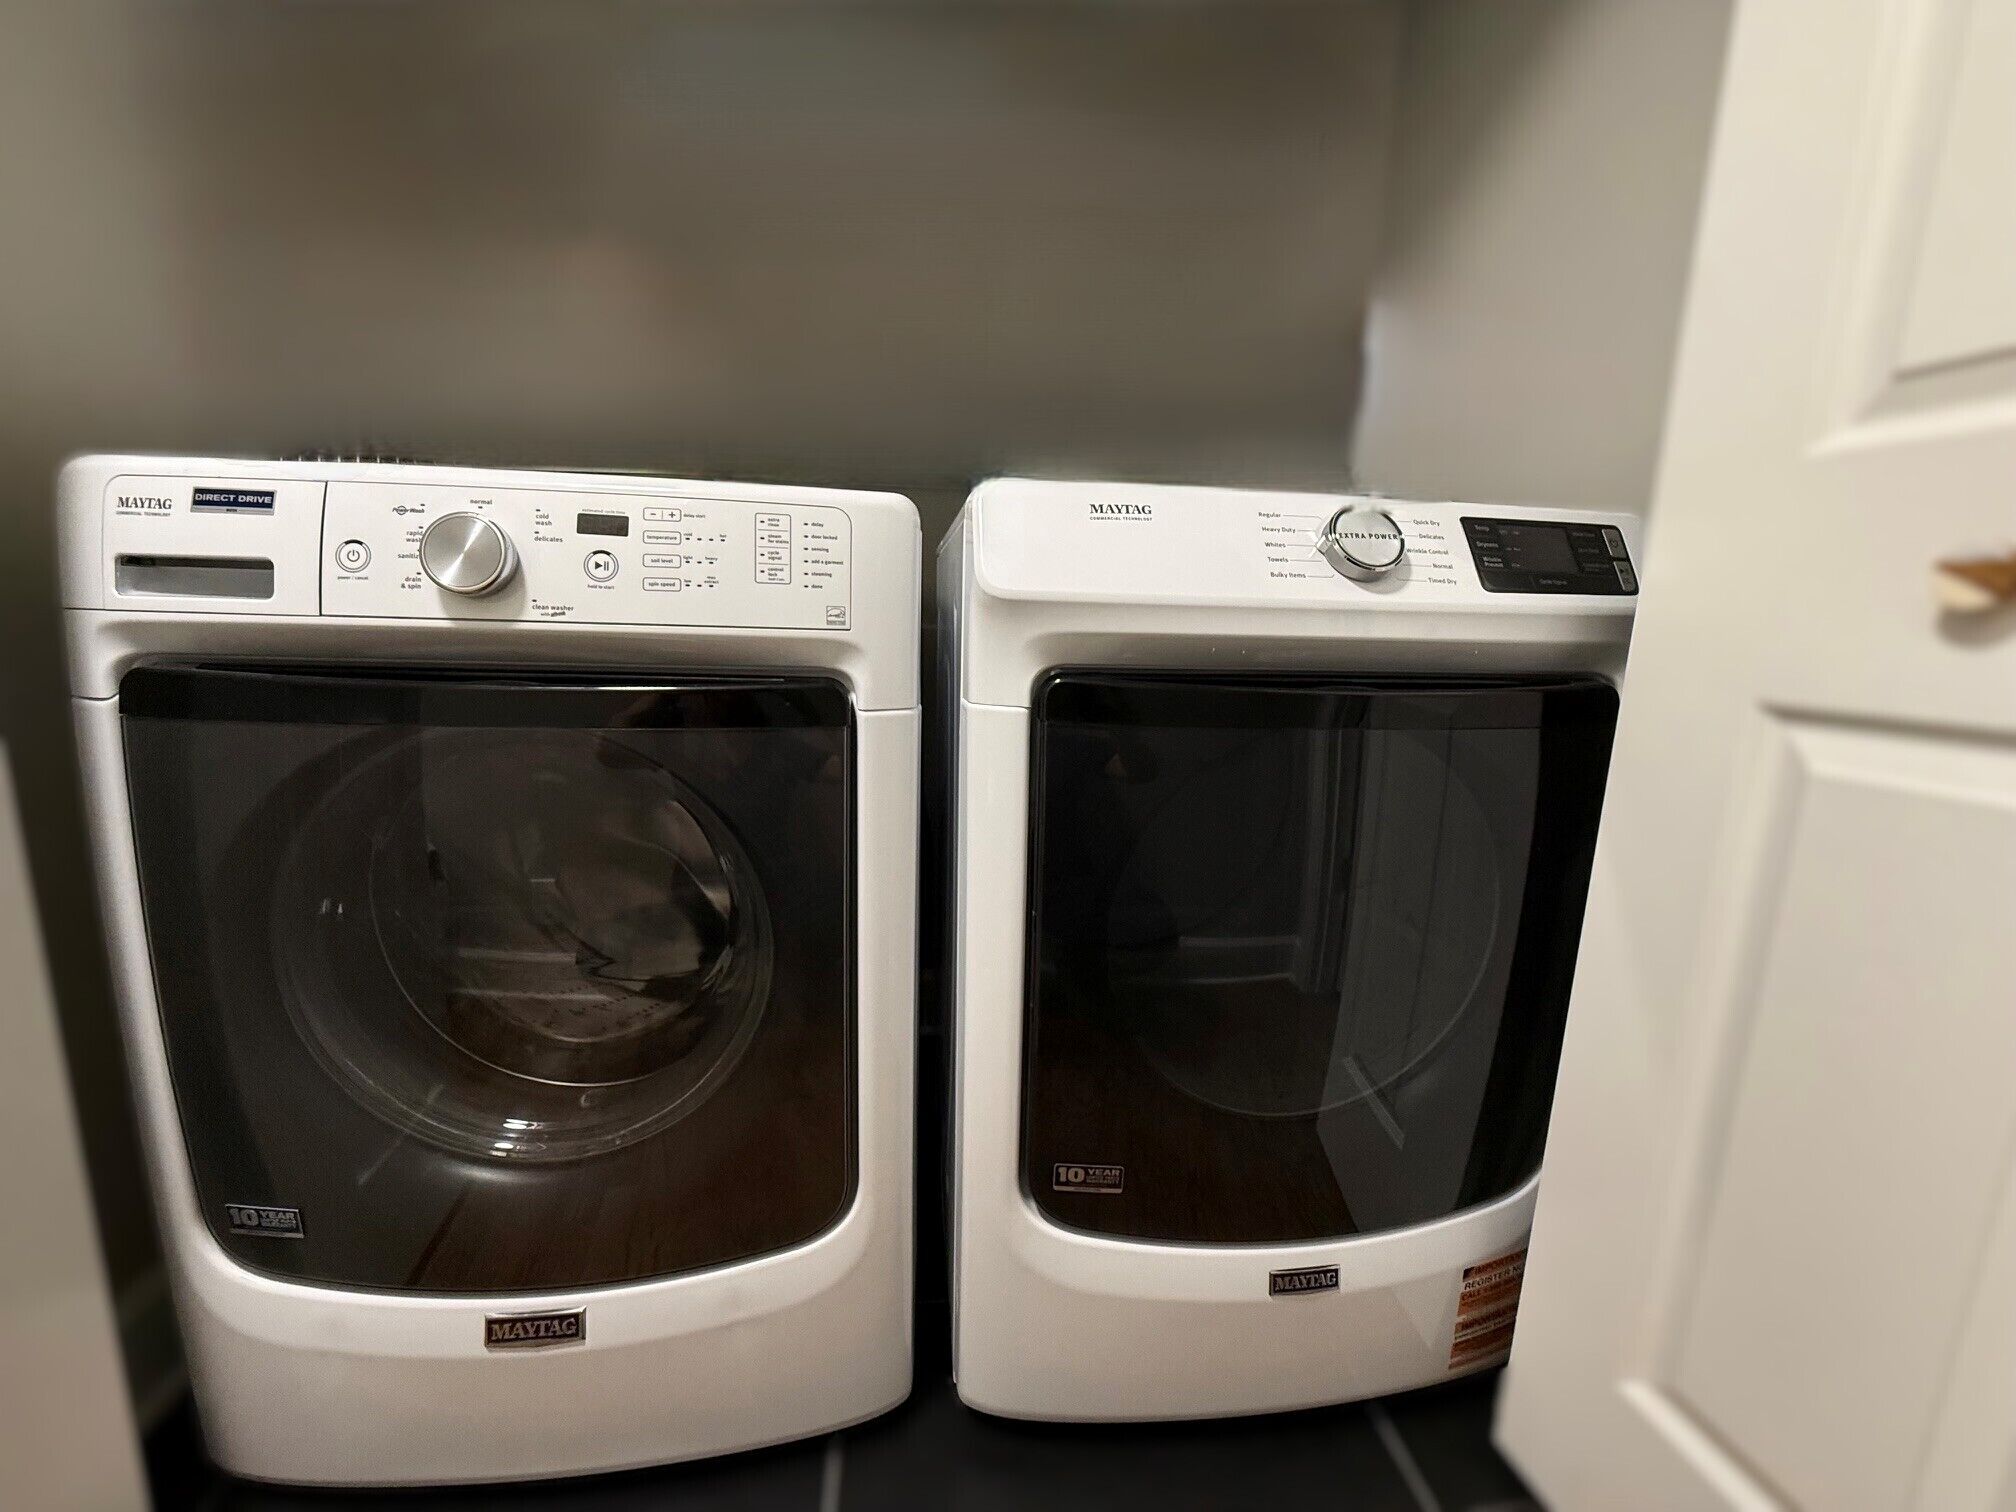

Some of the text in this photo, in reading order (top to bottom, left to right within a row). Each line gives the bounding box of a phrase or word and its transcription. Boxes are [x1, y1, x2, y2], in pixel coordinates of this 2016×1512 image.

[117, 496, 172, 509] MAYTAG
[195, 493, 273, 504] DIRECT DRIVE
[1089, 503, 1152, 514] MAYTAG
[1058, 1166, 1085, 1183] 10
[1087, 1168, 1121, 1176] YEAR
[229, 1207, 259, 1227] 10
[259, 1210, 296, 1219] YEAR
[1275, 1272, 1337, 1291] MAYTAG
[1464, 1270, 1510, 1291] REGISTER
[491, 1318, 578, 1341] MAYTAG
